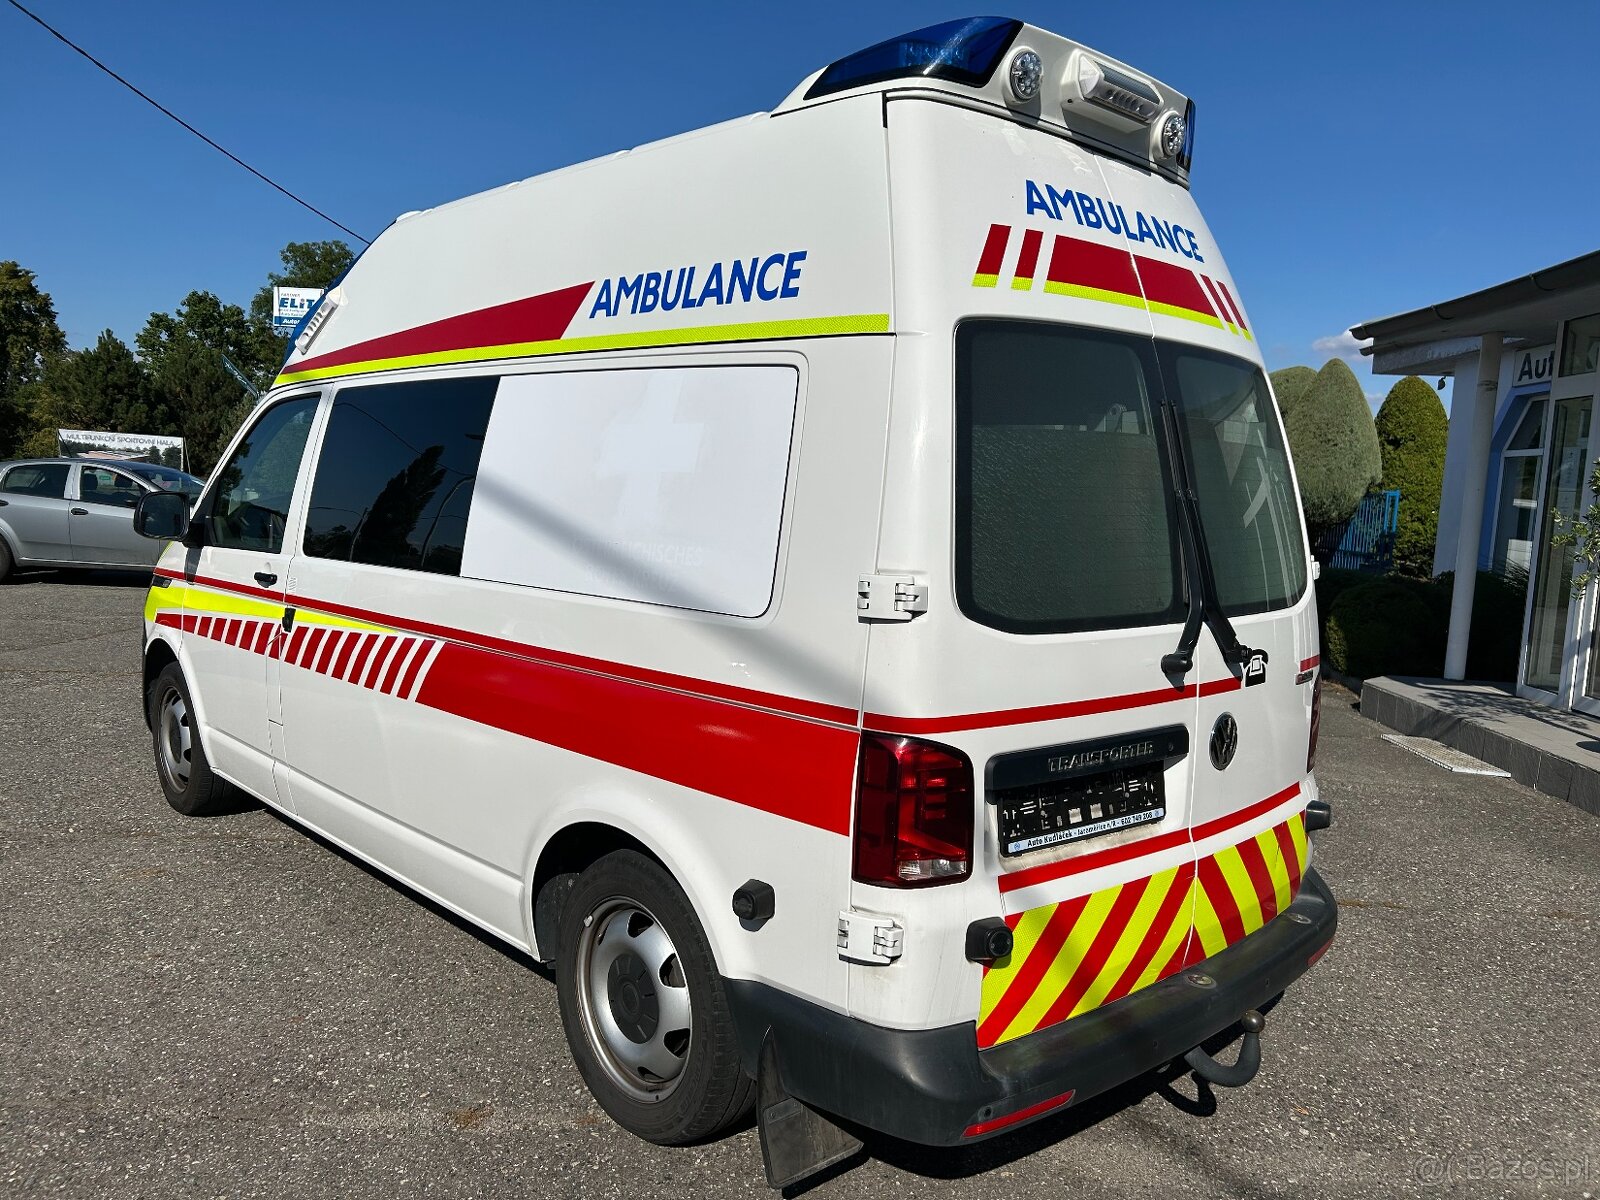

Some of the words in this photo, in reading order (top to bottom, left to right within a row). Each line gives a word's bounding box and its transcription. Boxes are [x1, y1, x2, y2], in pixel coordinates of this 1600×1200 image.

[1025, 179, 1205, 263] AMBULANCE
[588, 250, 808, 318] AMBULANCE
[156, 438, 175, 447] HALA
[1048, 742, 1153, 771] TRANSPORTER
[1027, 839, 1043, 848] Auto
